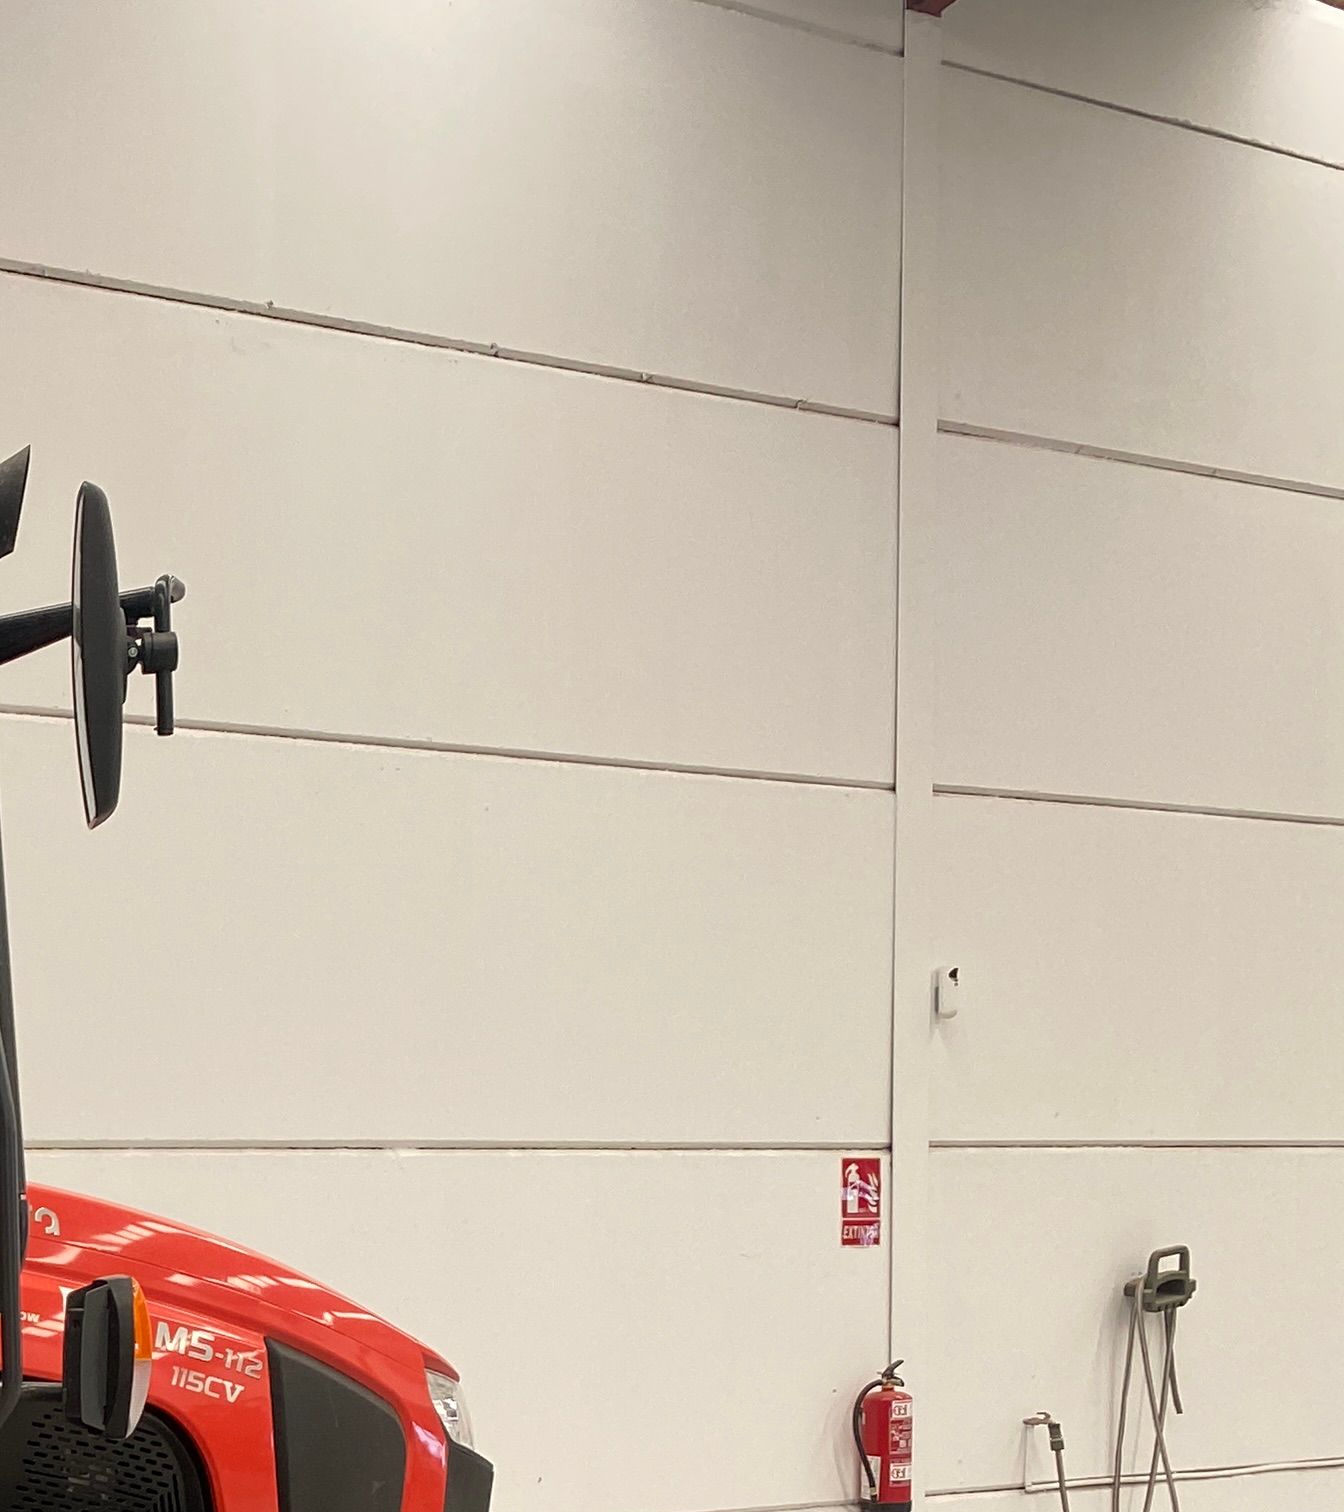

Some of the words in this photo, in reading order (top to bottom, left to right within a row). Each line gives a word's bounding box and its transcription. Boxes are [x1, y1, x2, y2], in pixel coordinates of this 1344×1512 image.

[843, 1224, 879, 1240] EXTIN
[154, 1320, 264, 1380] M5-112
[170, 1365, 246, 1404] 115CV
